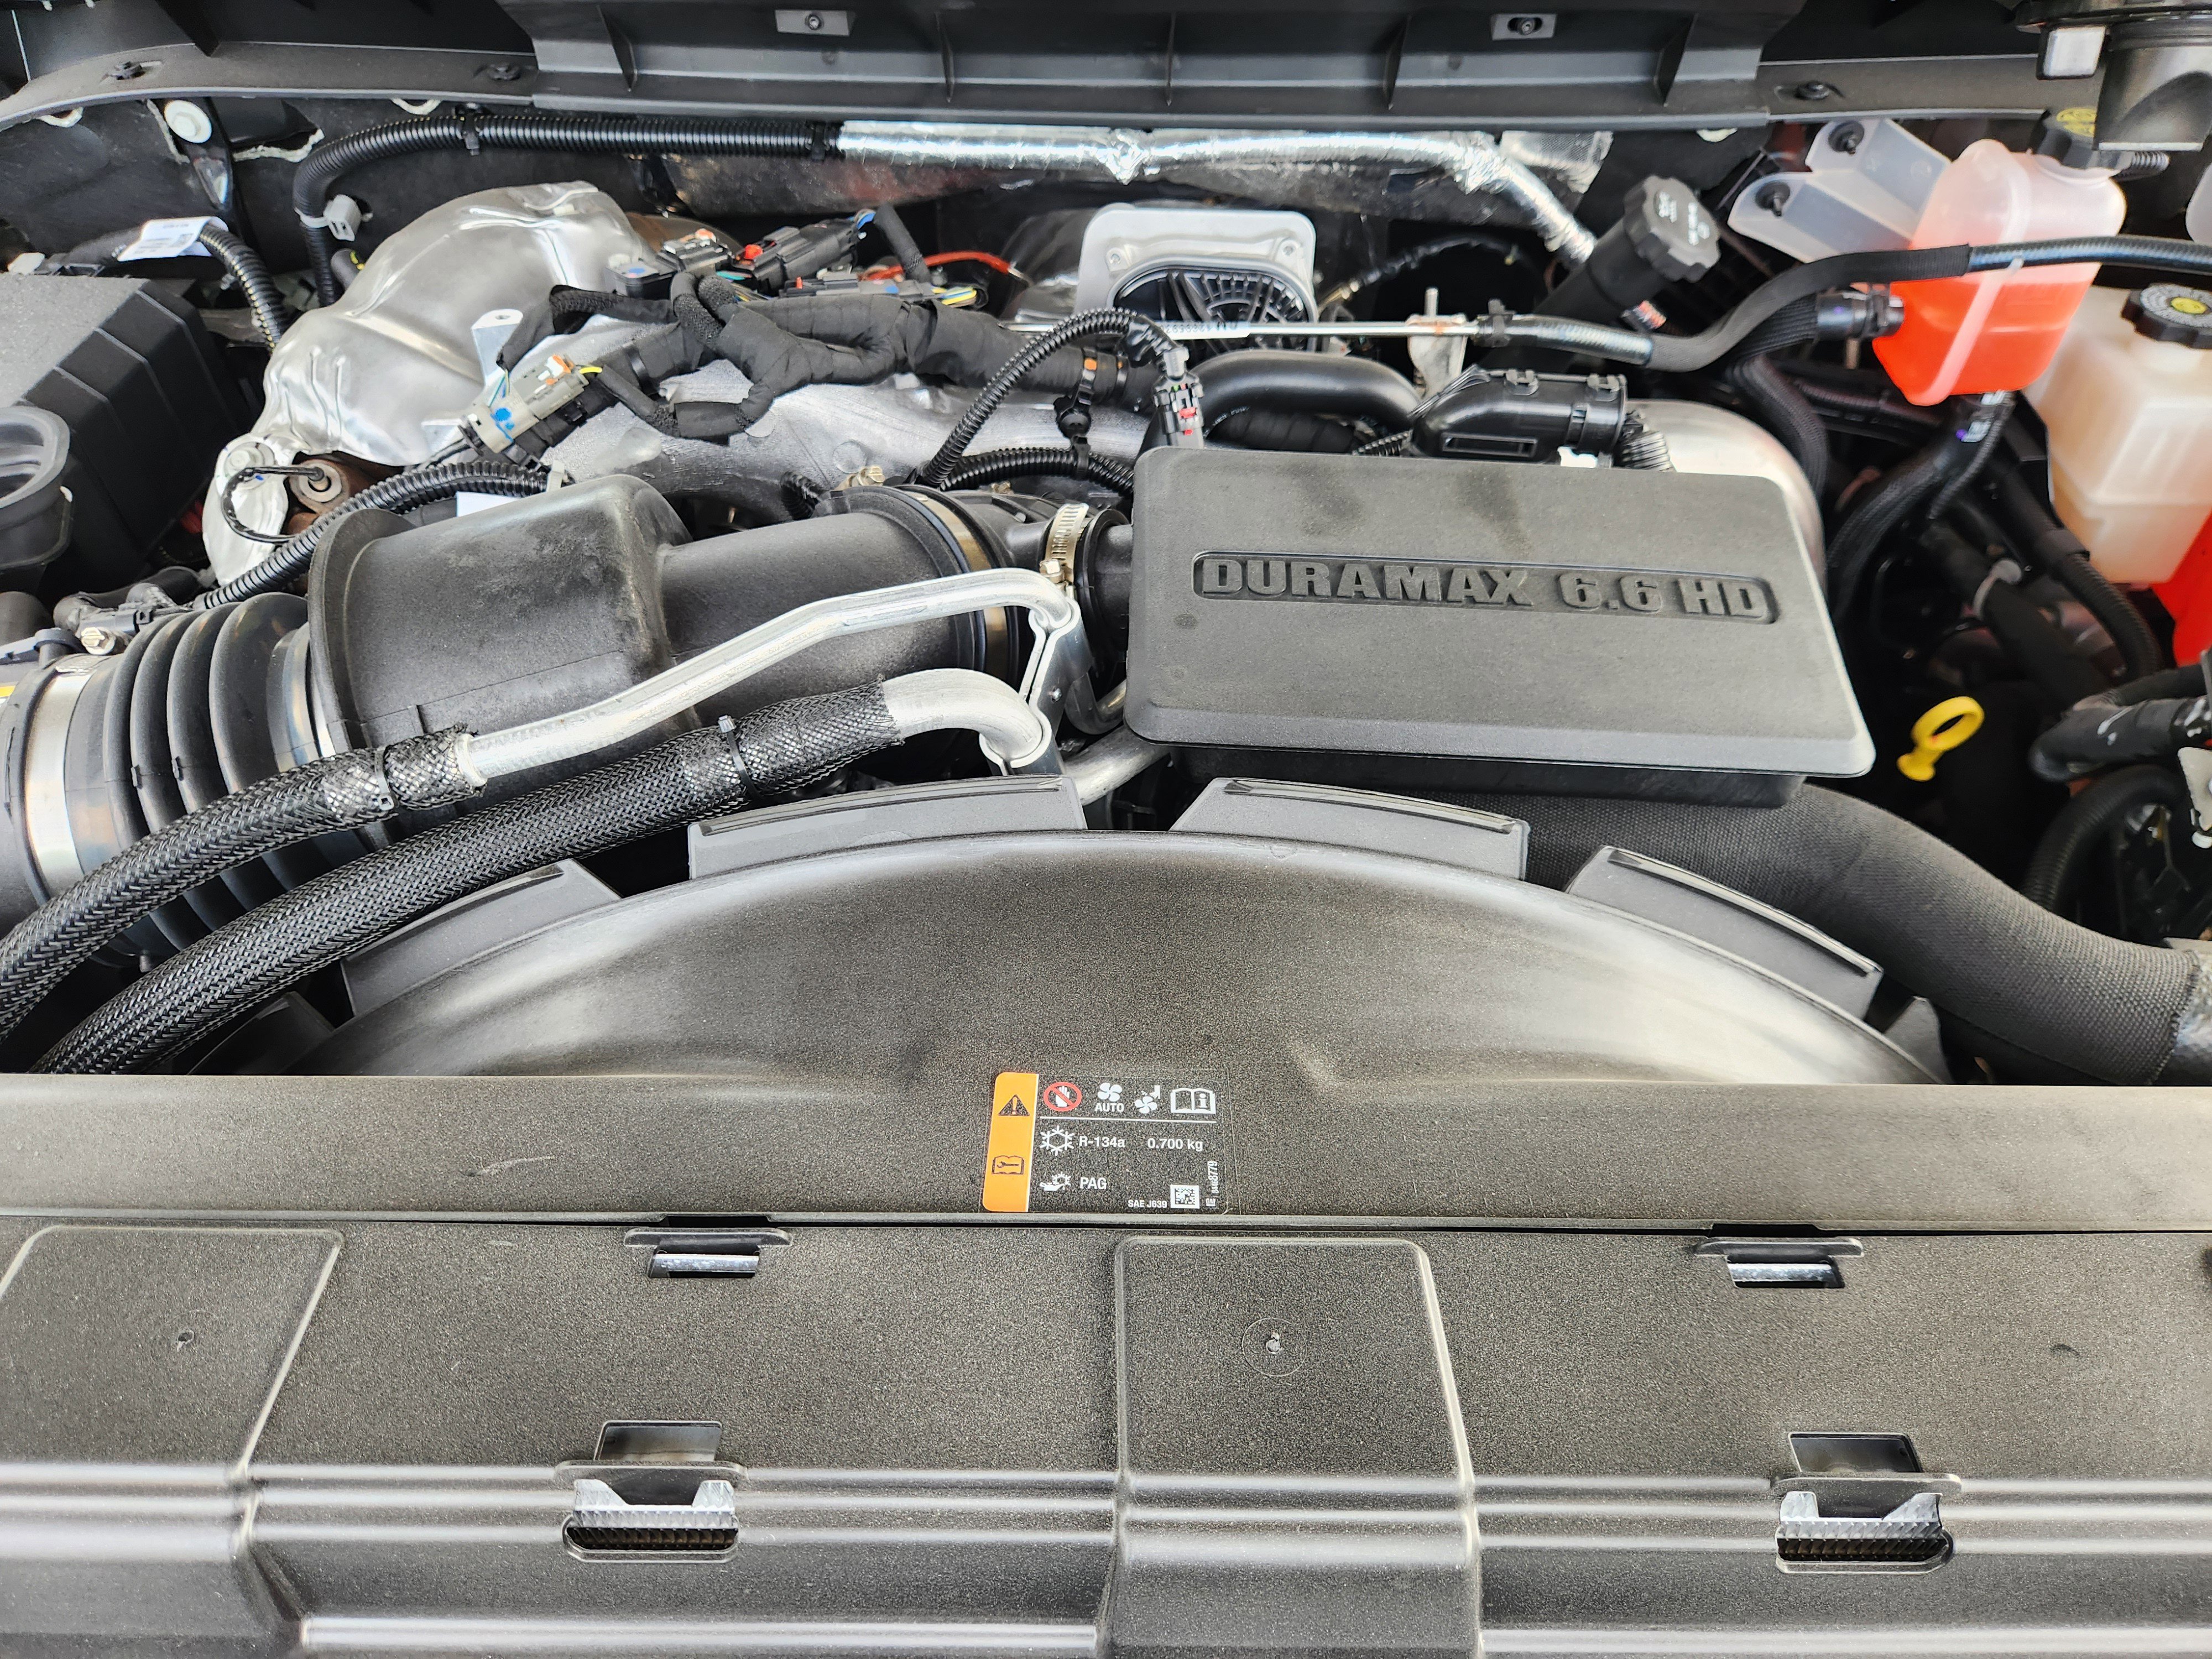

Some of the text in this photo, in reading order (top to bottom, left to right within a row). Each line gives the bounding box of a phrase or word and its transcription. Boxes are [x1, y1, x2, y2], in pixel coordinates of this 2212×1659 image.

[1202, 559, 1767, 618] DURAMAX 6.6 HD
[1094, 1102, 1124, 1113] AUTO
[1079, 1135, 1203, 1152] R-134a 0.700 kg
[1079, 1177, 1108, 1190] PAG
[1128, 1199, 1168, 1208] SAE J639
